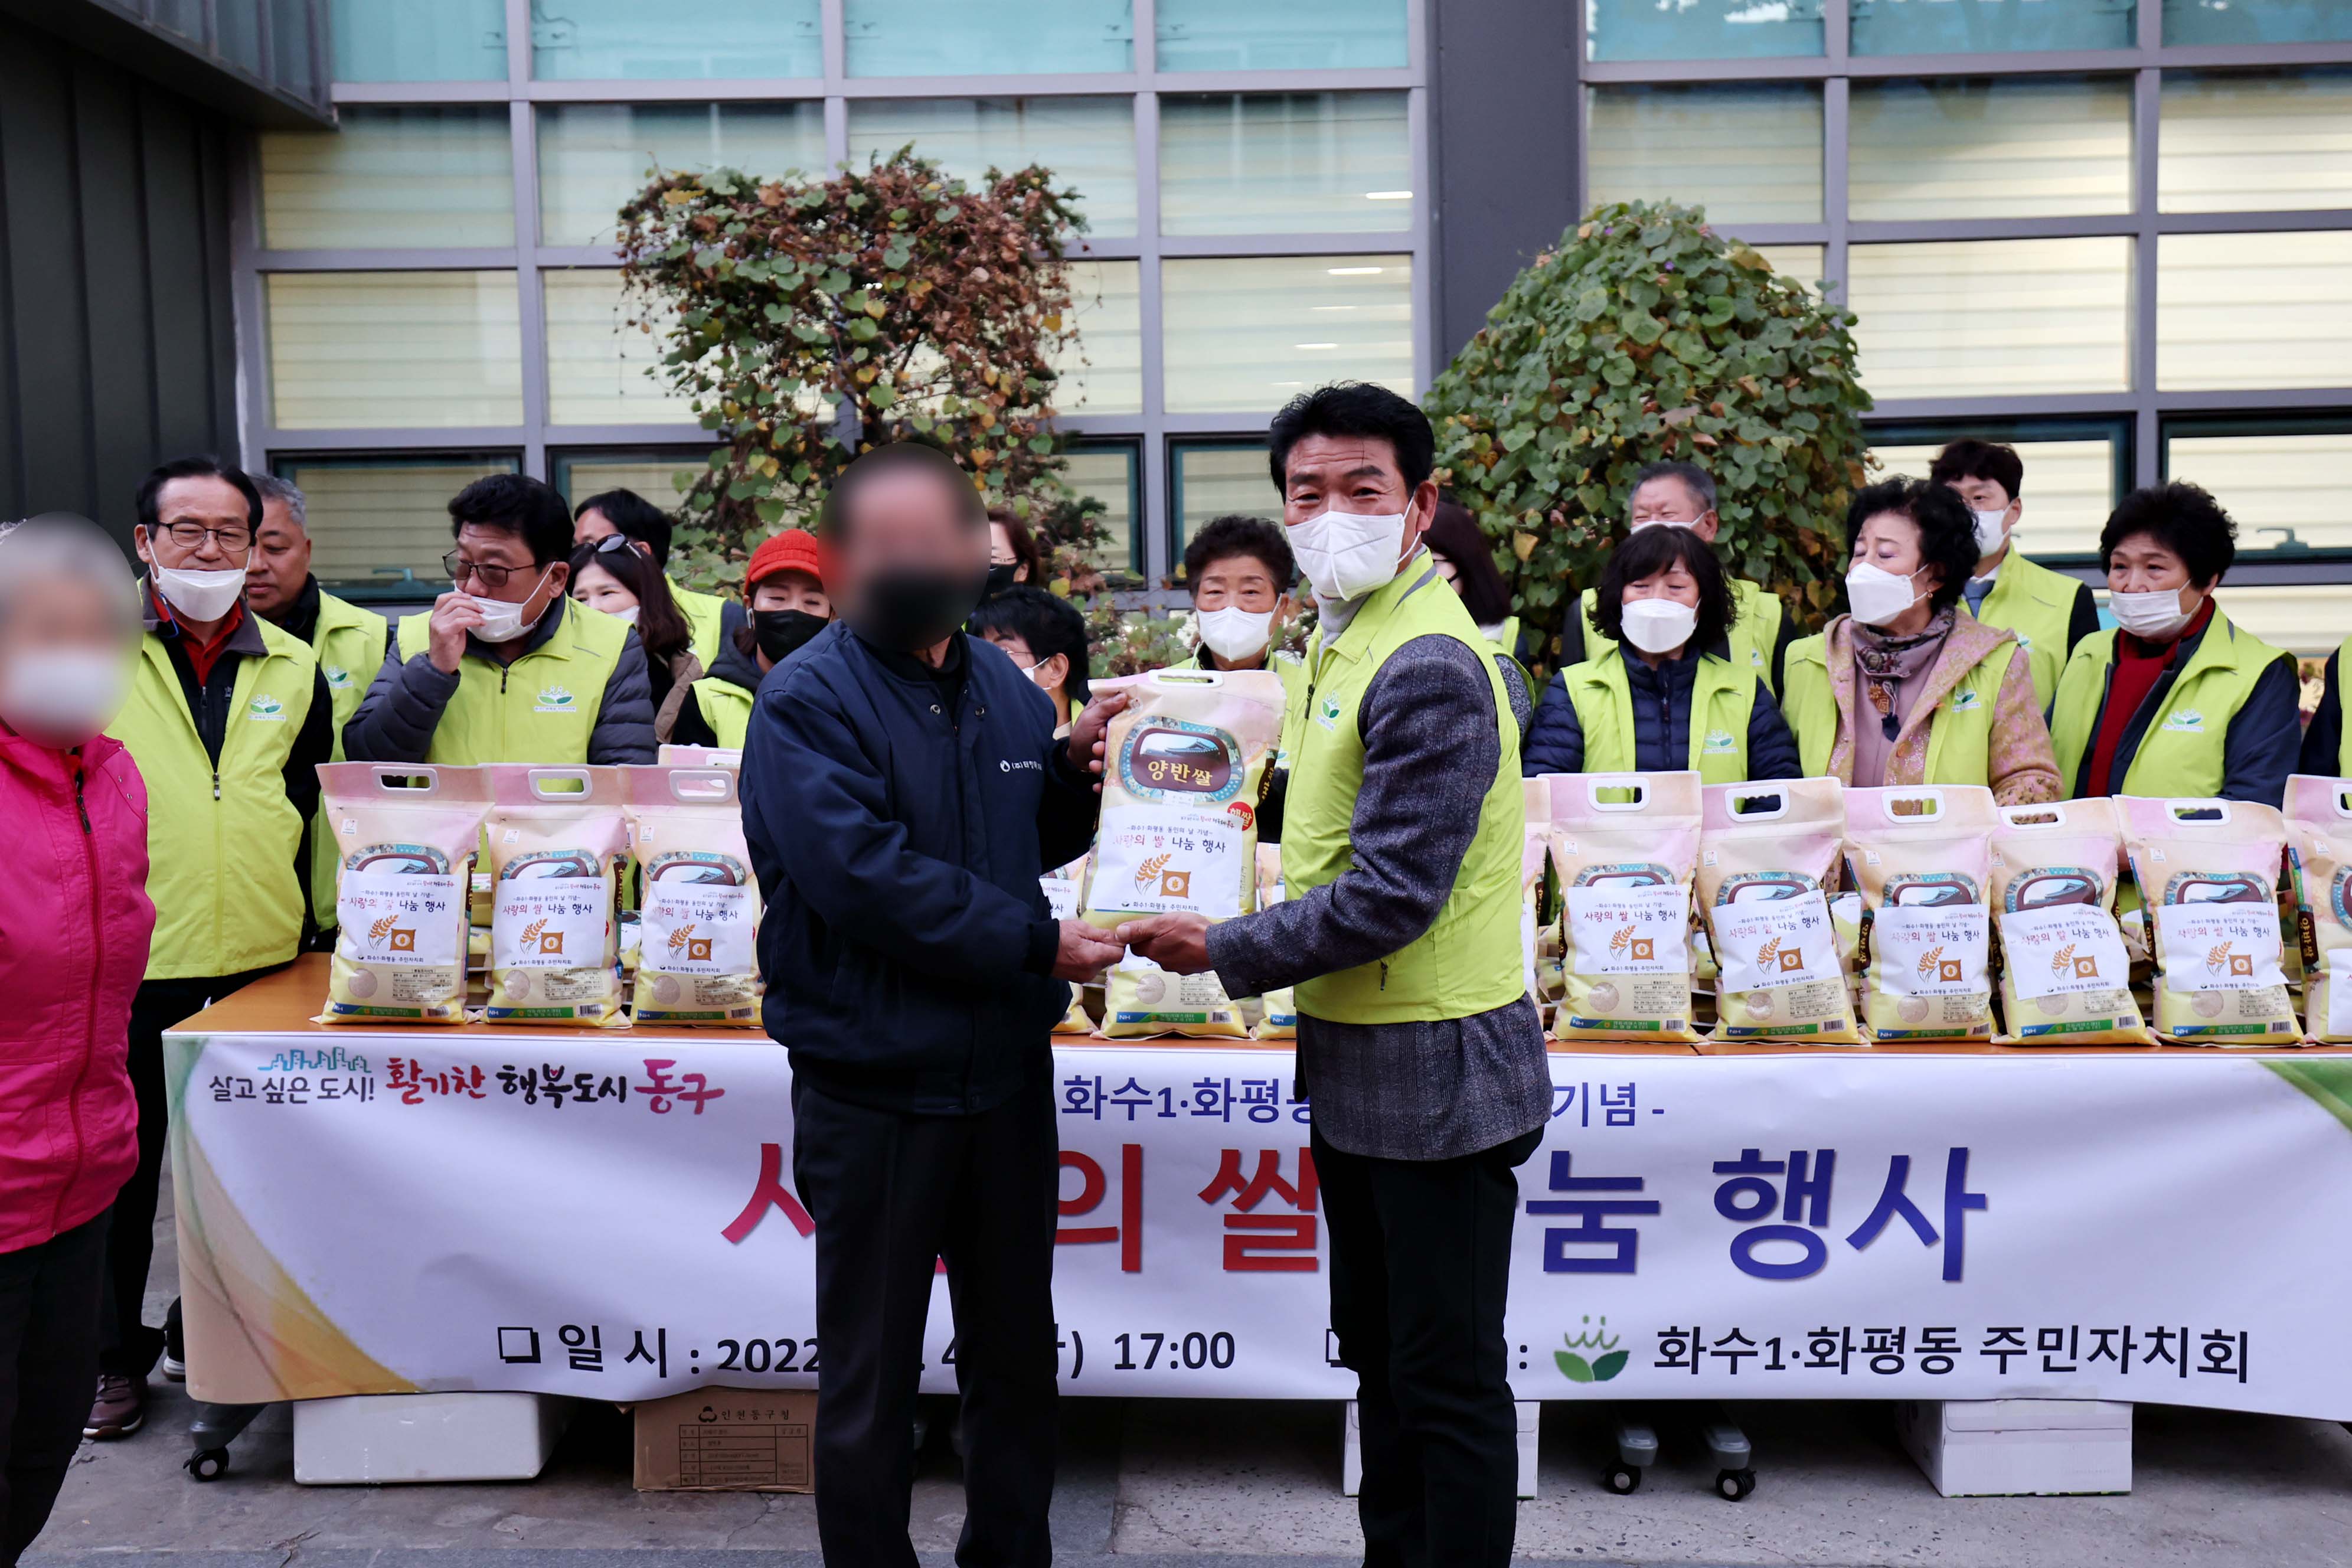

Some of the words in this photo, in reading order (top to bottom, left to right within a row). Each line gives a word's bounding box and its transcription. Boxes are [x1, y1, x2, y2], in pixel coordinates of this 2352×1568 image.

[1148, 760, 1213, 786] 양반쌀
[1172, 837, 1195, 851] 나눔
[1203, 839, 1226, 853] 행사
[400, 900, 419, 912] 나눔
[425, 901, 446, 913] 행사
[503, 904, 527, 916] 사랑의
[533, 905, 543, 915] 쌀
[548, 904, 566, 914] 나눔
[573, 904, 592, 914] 행사
[696, 909, 714, 920] 나눔
[719, 910, 737, 921] 행사
[1585, 912, 1612, 922] 사랑의
[1619, 912, 1628, 921] 쌀
[1635, 912, 1653, 921] 나눔
[1659, 910, 1677, 921] 행사
[1778, 922, 1796, 930] 나눔
[1802, 916, 1819, 929] 행사
[1942, 931, 1959, 941] 나눔
[1965, 930, 1979, 941] 행사
[2072, 929, 2090, 938] 나눔
[2229, 926, 2248, 937] 나눔
[2253, 927, 2269, 937] 행사
[210, 1076, 256, 1102] 살고
[262, 1076, 311, 1104] 싶은
[317, 1076, 374, 1102] 도시!
[386, 1057, 486, 1105] 활기찬
[496, 1063, 627, 1108] 행복도시
[633, 1059, 725, 1115] 동구
[1198, 1145, 1320, 1271] 쌀
[1525, 1150, 1660, 1273] 눔
[1713, 1147, 1986, 1282] 행사
[1115, 1332, 1234, 1369] 17:00
[1654, 1326, 1961, 1375] 화수1·화평동
[1979, 1325, 2248, 1383] 주민자치회
